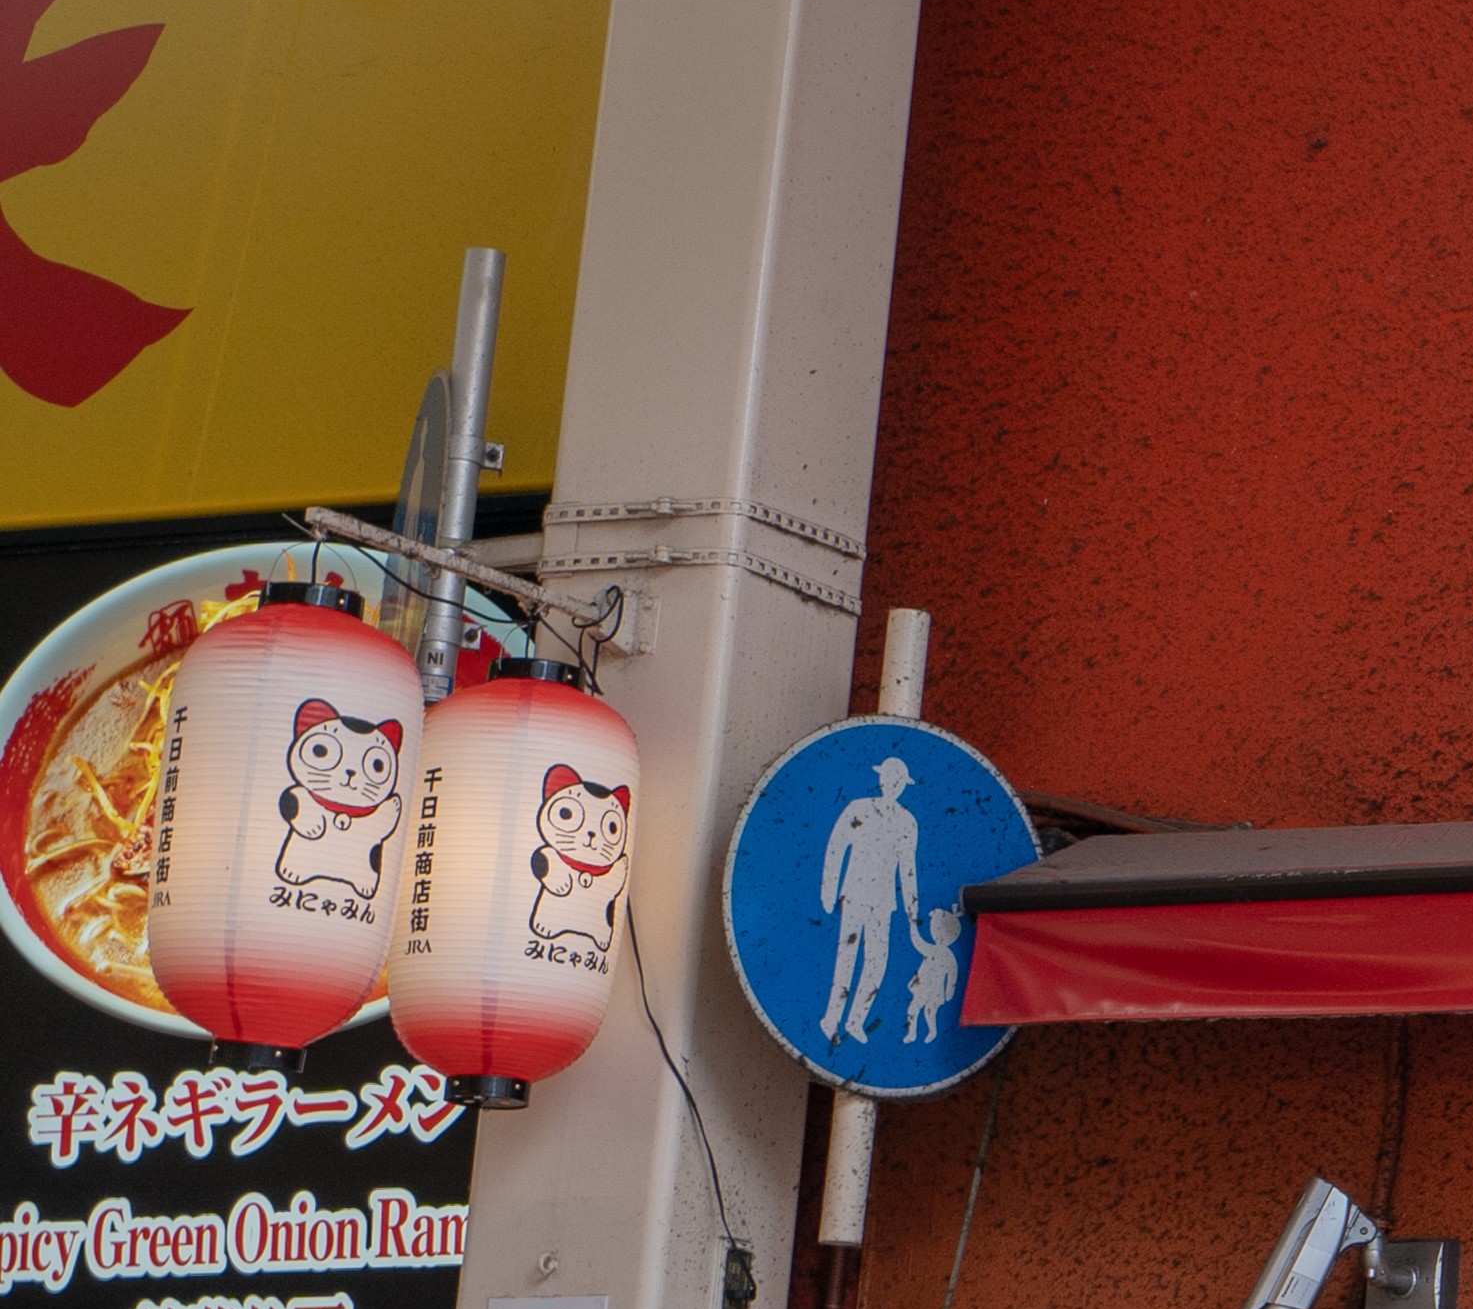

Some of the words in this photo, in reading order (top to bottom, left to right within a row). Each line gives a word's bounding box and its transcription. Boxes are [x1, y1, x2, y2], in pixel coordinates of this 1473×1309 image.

[153, 706, 189, 887] 千日前商店街
[410, 768, 443, 933] 千日前商店街
[269, 885, 377, 925] みにゃみん
[405, 940, 432, 955] JRA
[525, 939, 610, 976] みにゃみん
[37, 1070, 465, 1160] 辛ネギラーメン
[92, 1203, 224, 1273] Green
[234, 1198, 365, 1267] Onion
